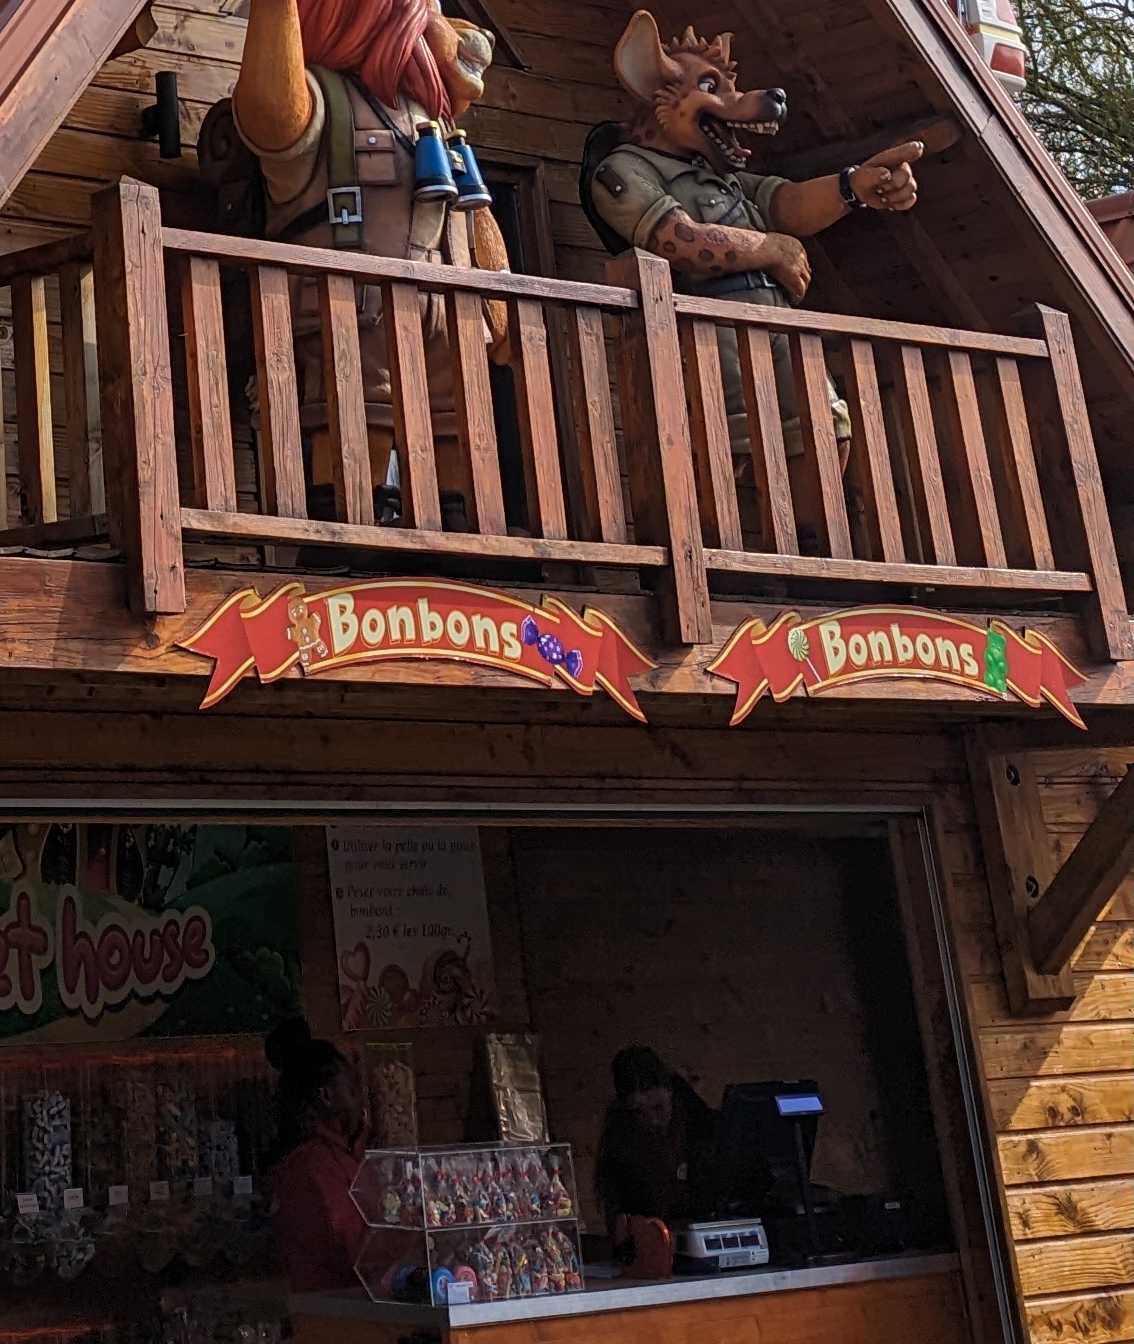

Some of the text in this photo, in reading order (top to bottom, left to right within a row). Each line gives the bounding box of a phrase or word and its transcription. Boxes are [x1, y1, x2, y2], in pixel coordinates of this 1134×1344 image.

[326, 592, 522, 661] Bonbons
[819, 620, 979, 678] Bonbons
[61, 895, 211, 1005] house
[403, 924, 417, 937] les
